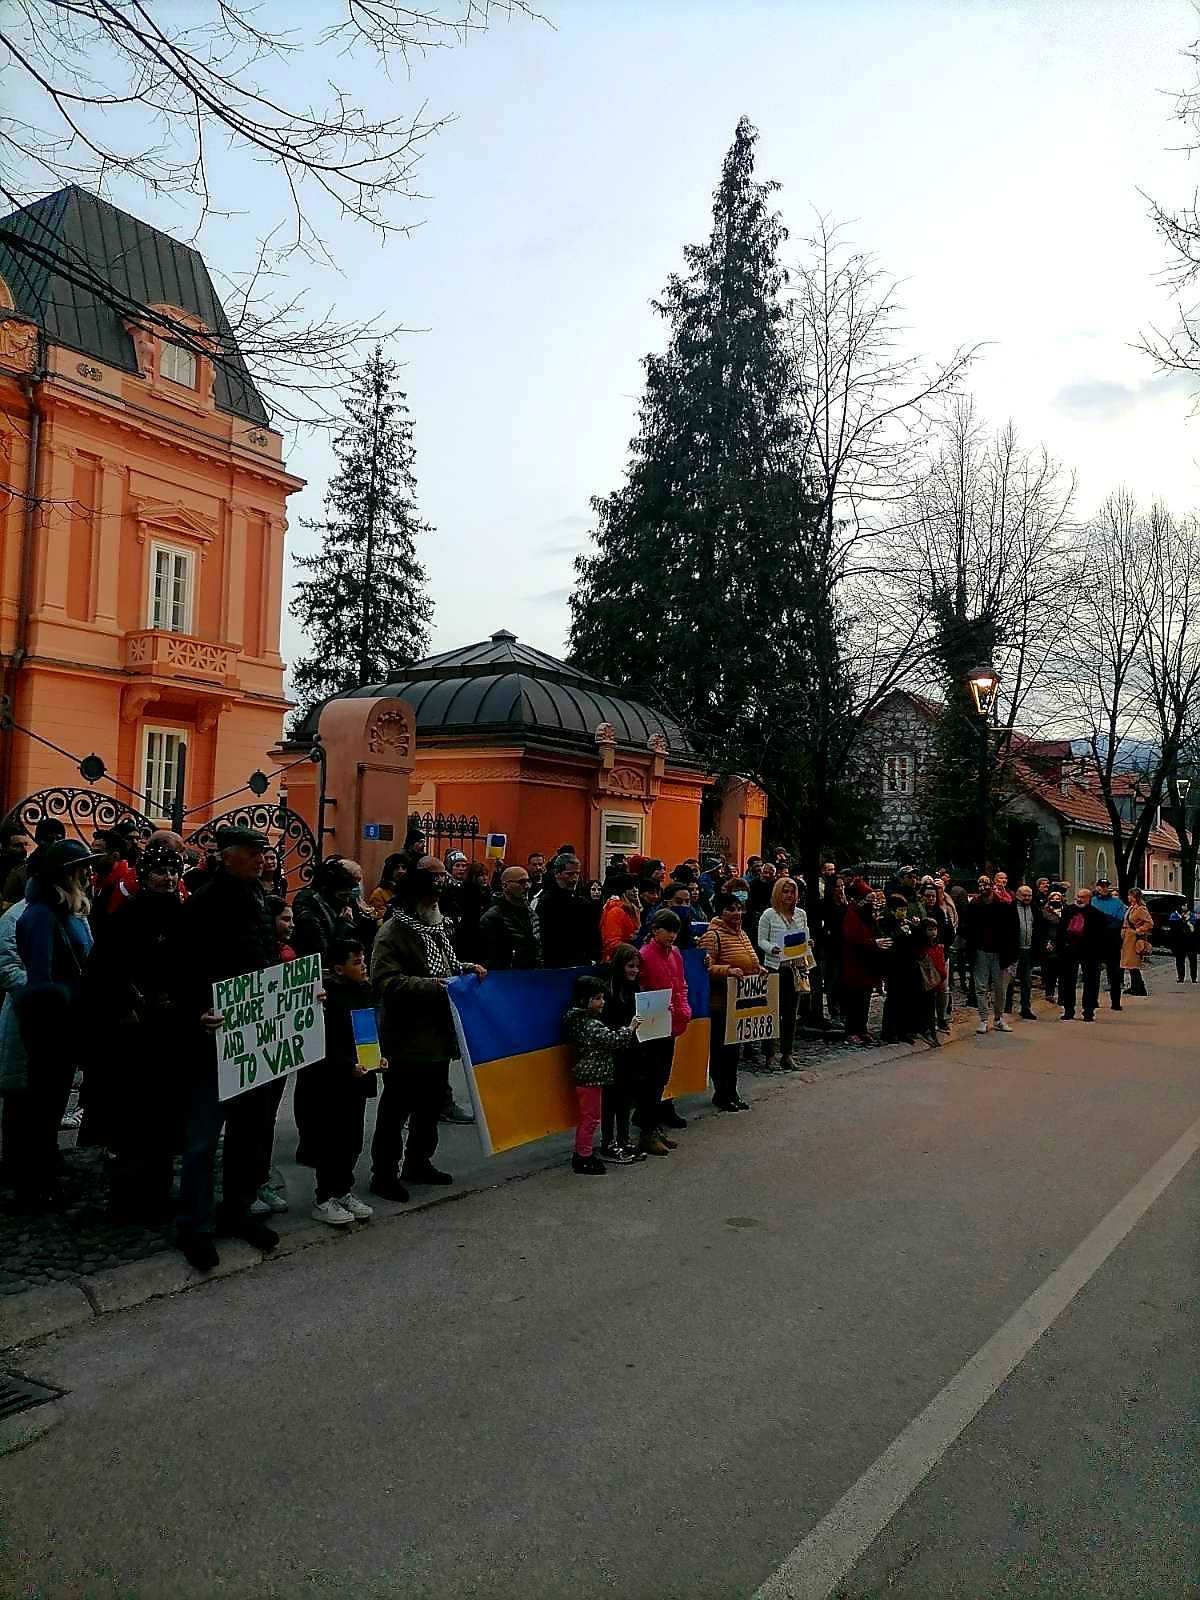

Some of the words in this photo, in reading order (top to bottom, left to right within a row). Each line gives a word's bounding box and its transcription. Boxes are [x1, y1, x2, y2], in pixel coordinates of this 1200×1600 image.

[216, 970, 265, 1009] PEOPLE
[267, 981, 278, 993] OF
[277, 984, 314, 1014] PUTIN
[223, 1031, 244, 1060] AND
[294, 1007, 314, 1031] GO
[737, 1015, 773, 1040] 15888
[234, 1053, 257, 1087] TO
[262, 1035, 305, 1075] WAR
